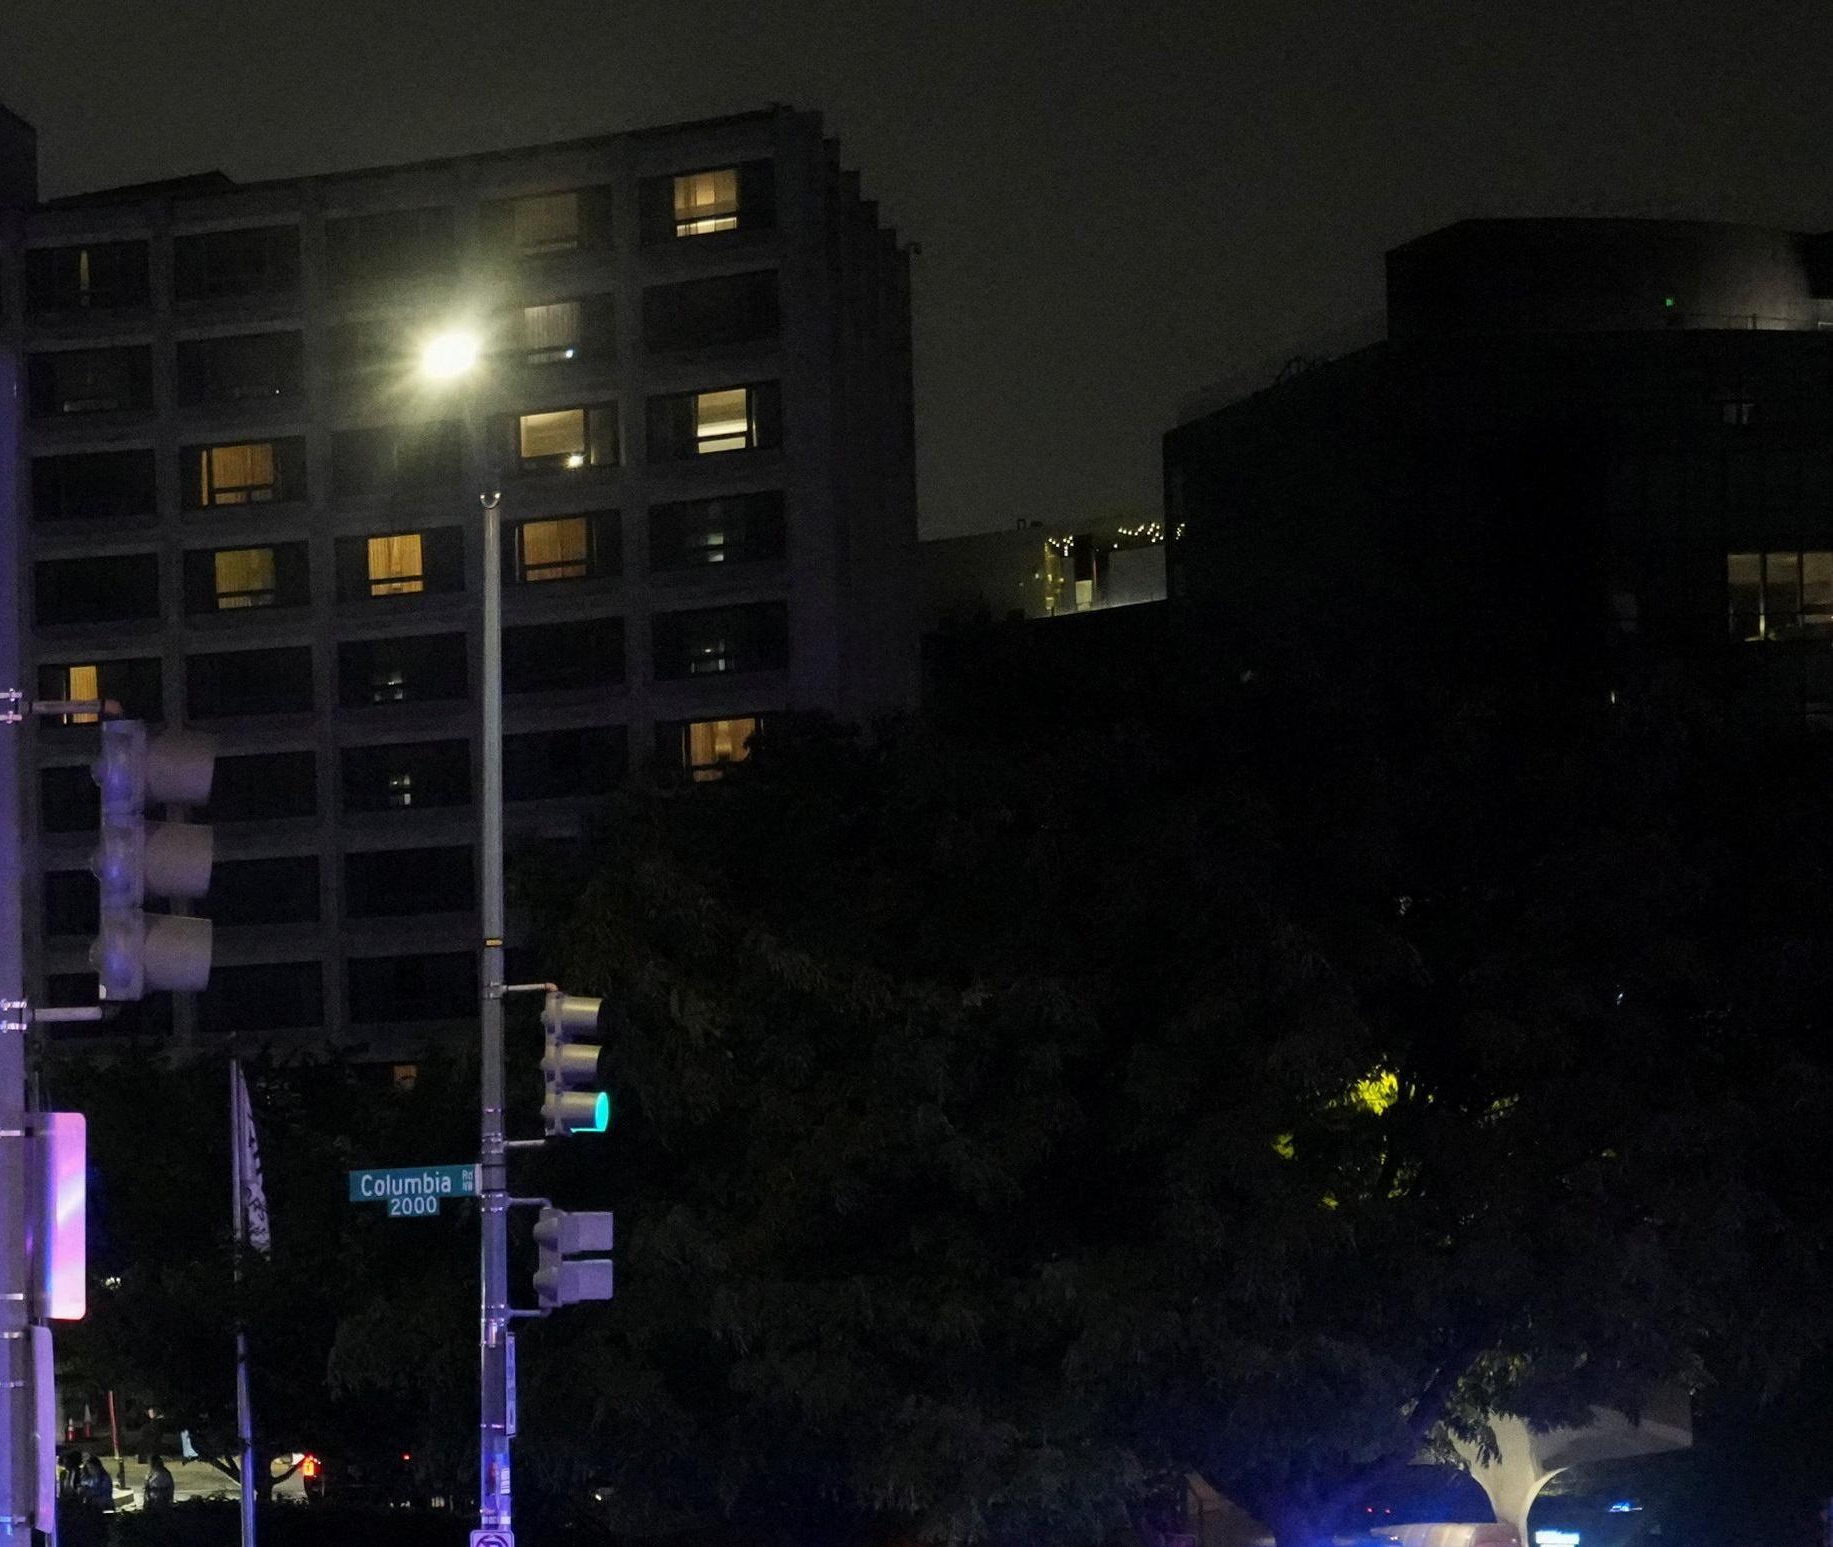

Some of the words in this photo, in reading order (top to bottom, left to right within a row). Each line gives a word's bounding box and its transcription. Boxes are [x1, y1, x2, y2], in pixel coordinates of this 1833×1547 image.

[360, 1171, 452, 1198] Columbia
[462, 1169, 474, 1181] Rd
[390, 1196, 437, 1216] 2000
